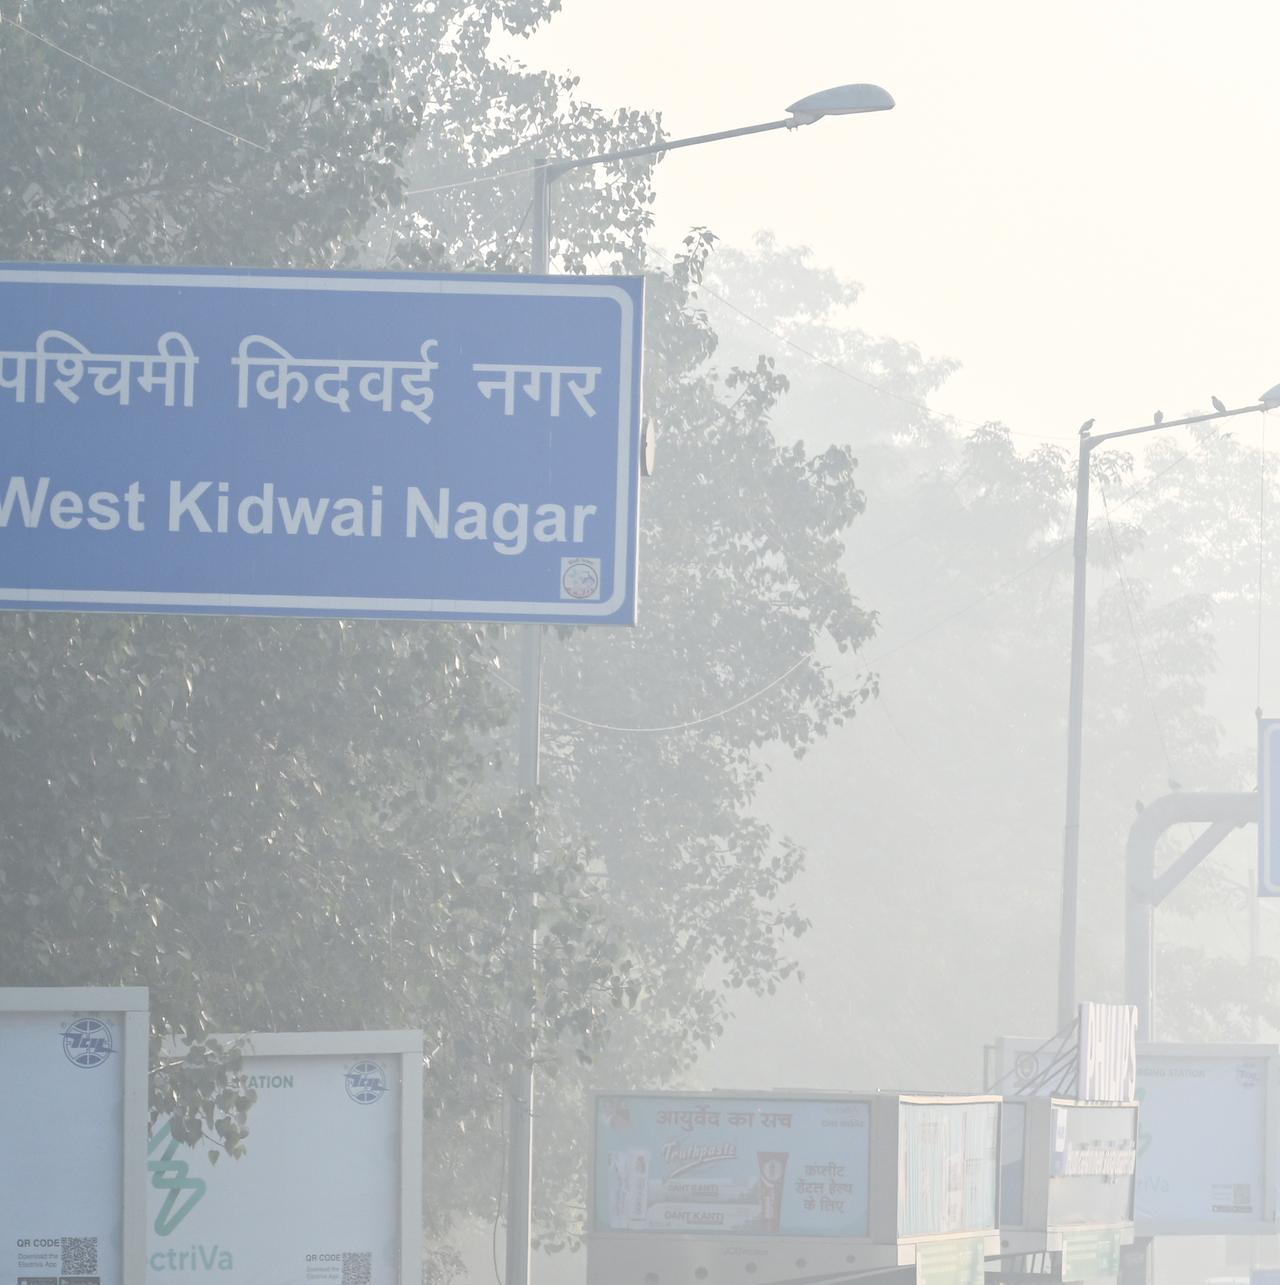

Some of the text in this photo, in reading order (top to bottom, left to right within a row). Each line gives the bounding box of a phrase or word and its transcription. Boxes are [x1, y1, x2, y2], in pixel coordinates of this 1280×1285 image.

[0, 330, 602, 425] पश्चिमी किदवई नगर
[0, 476, 597, 556] West Kidwai Nagar
[656, 1104, 792, 1131] आयुर्वेद का सच
[149, 1244, 233, 1271] ctriVa
